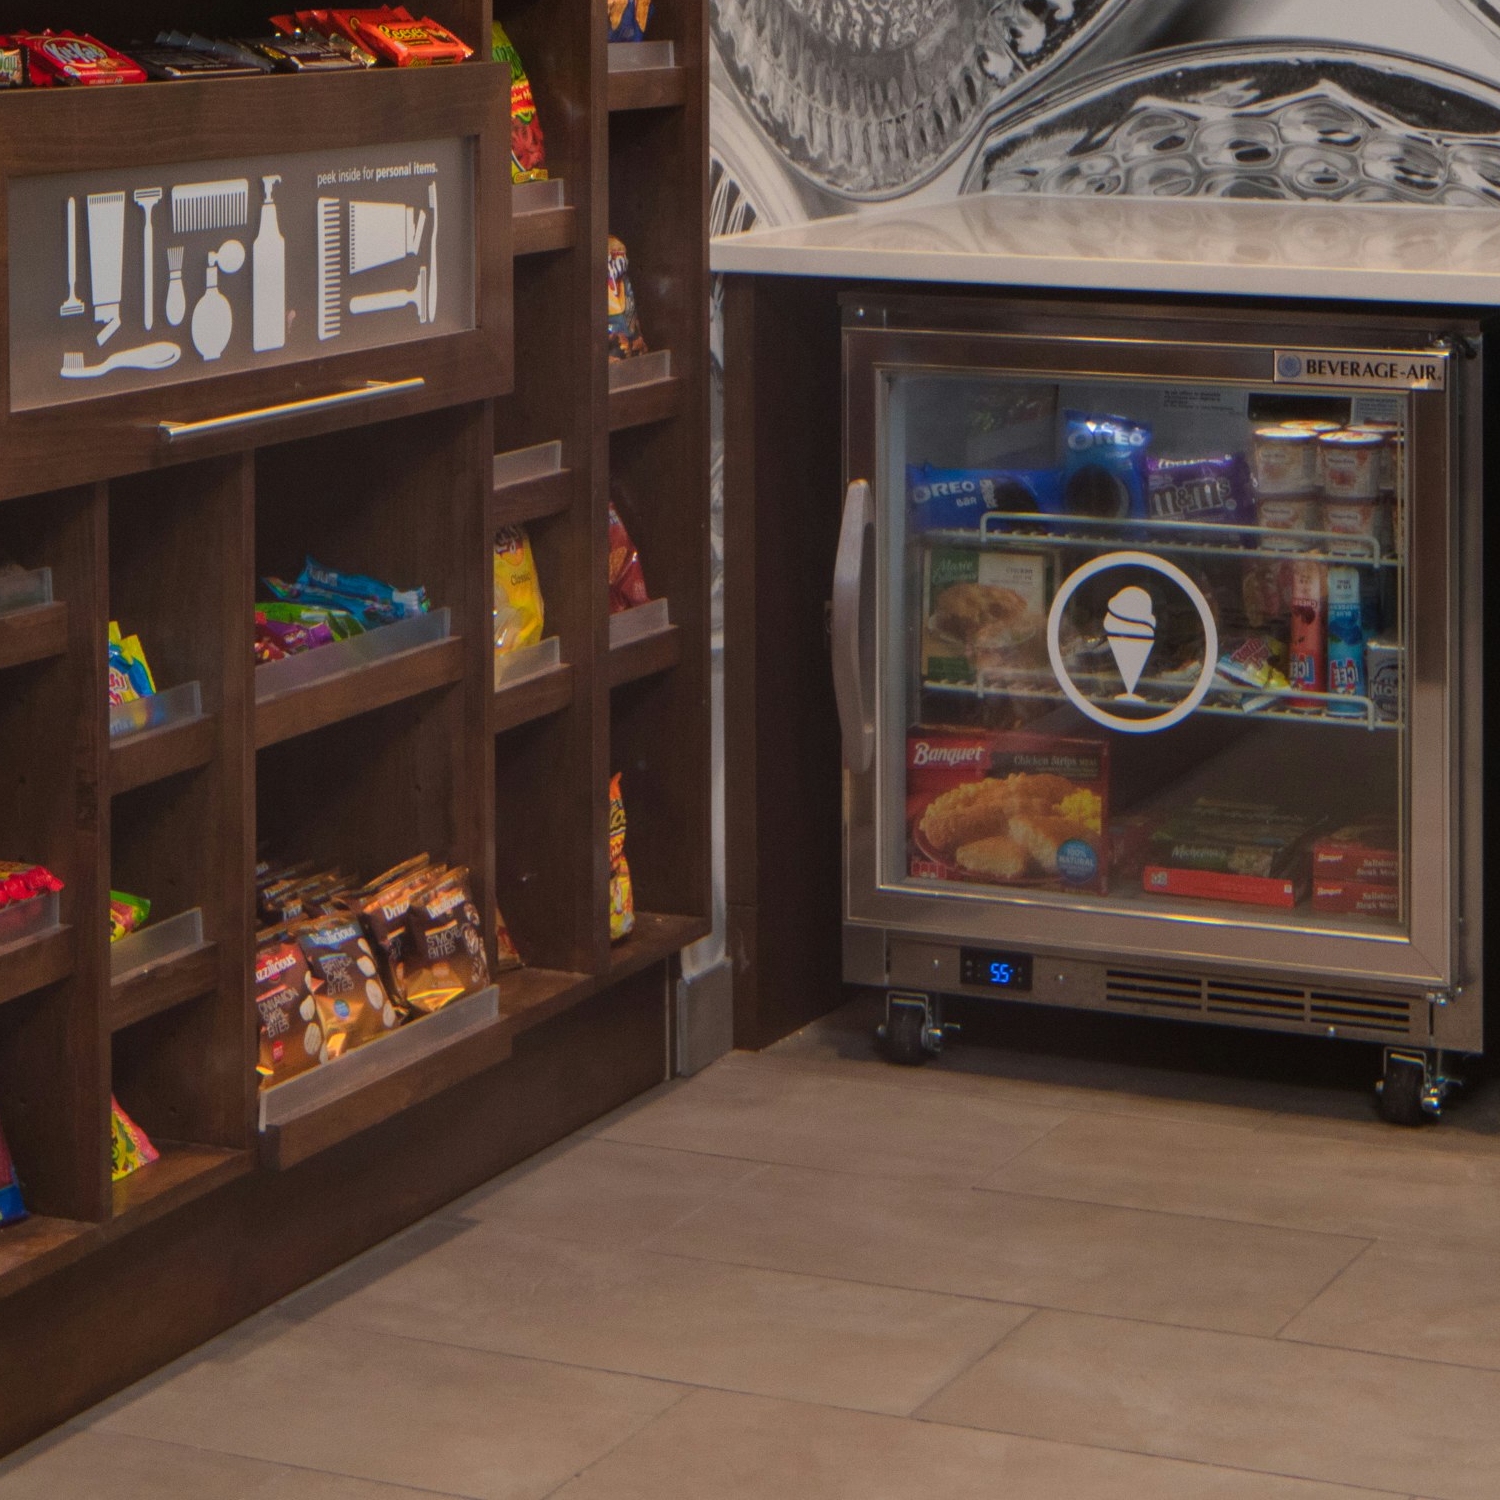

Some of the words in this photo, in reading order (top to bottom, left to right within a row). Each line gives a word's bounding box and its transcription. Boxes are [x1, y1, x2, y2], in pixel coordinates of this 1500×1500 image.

[317, 169, 337, 188] peek
[338, 167, 361, 183] inside
[375, 161, 412, 182] personal
[413, 160, 439, 176] items.
[1305, 358, 1439, 382] BEVERAGE-AIR
[1067, 429, 1145, 451] OREO
[912, 480, 976, 505] OREO
[913, 742, 986, 767] Banquet
[1013, 754, 1049, 767] Chicken
[1058, 855, 1095, 867] NATURAL
